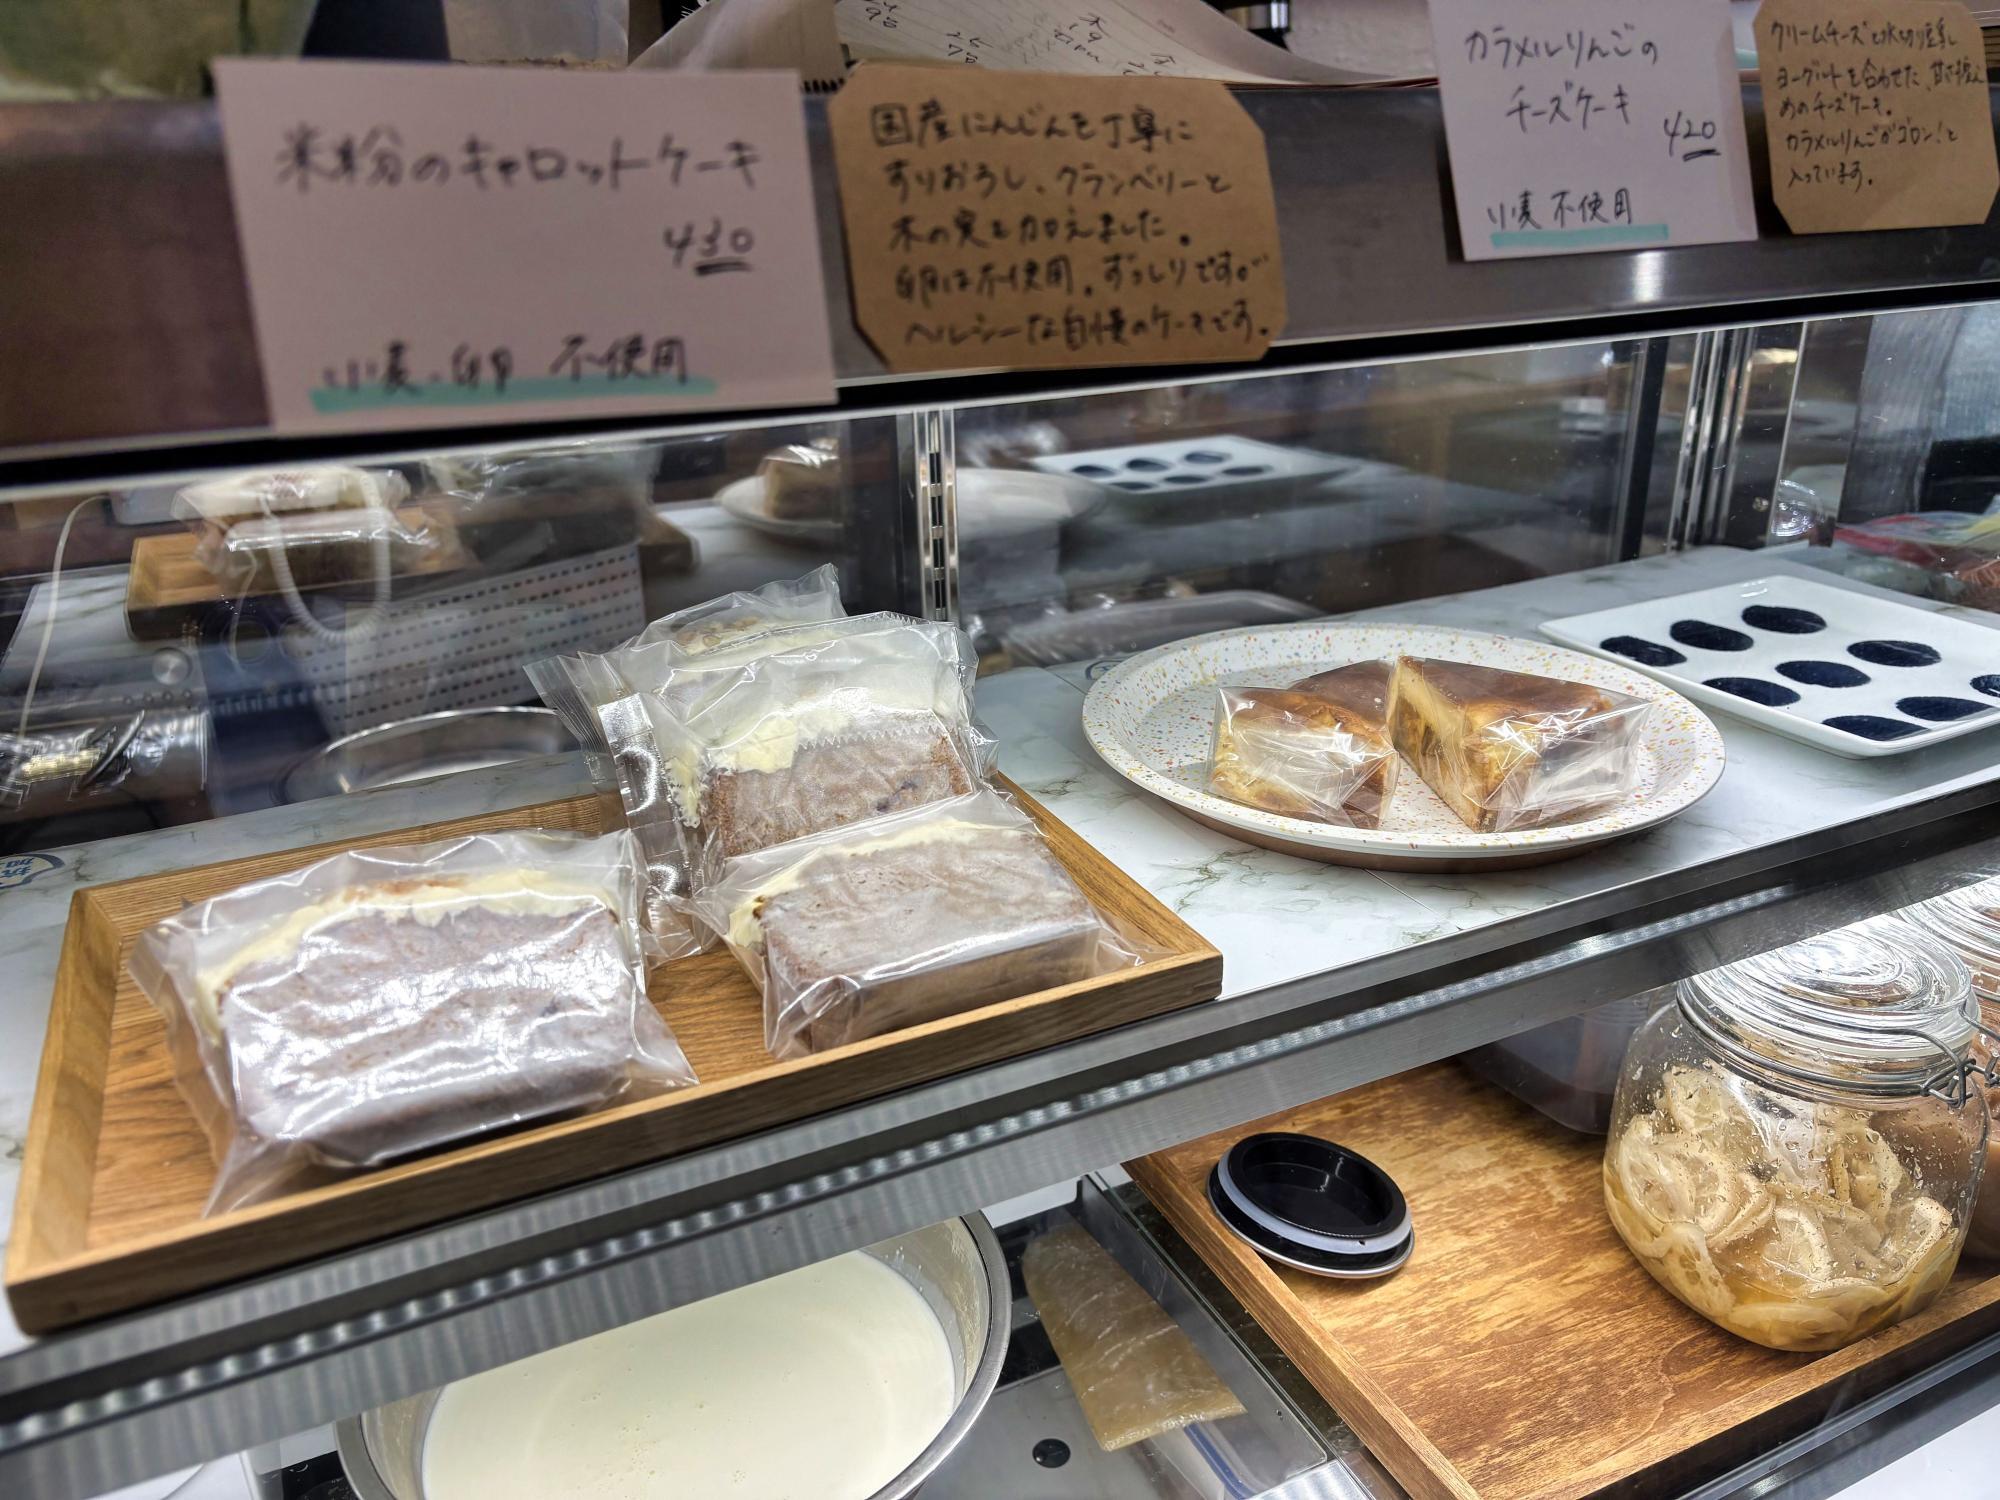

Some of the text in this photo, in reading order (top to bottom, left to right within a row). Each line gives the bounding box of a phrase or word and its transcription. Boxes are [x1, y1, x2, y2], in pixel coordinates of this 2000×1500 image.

[1465, 22, 1659, 68] カラメルりんごの
[871, 99, 1198, 152] 国産にんじんを丁寧に
[1505, 80, 1630, 133] チーズケーキ
[274, 122, 761, 193] 米粉のキャロットケーキ
[1663, 111, 1717, 157] 420
[884, 157, 1233, 202] すりおろし、クランベリーと
[664, 218, 756, 268] 430
